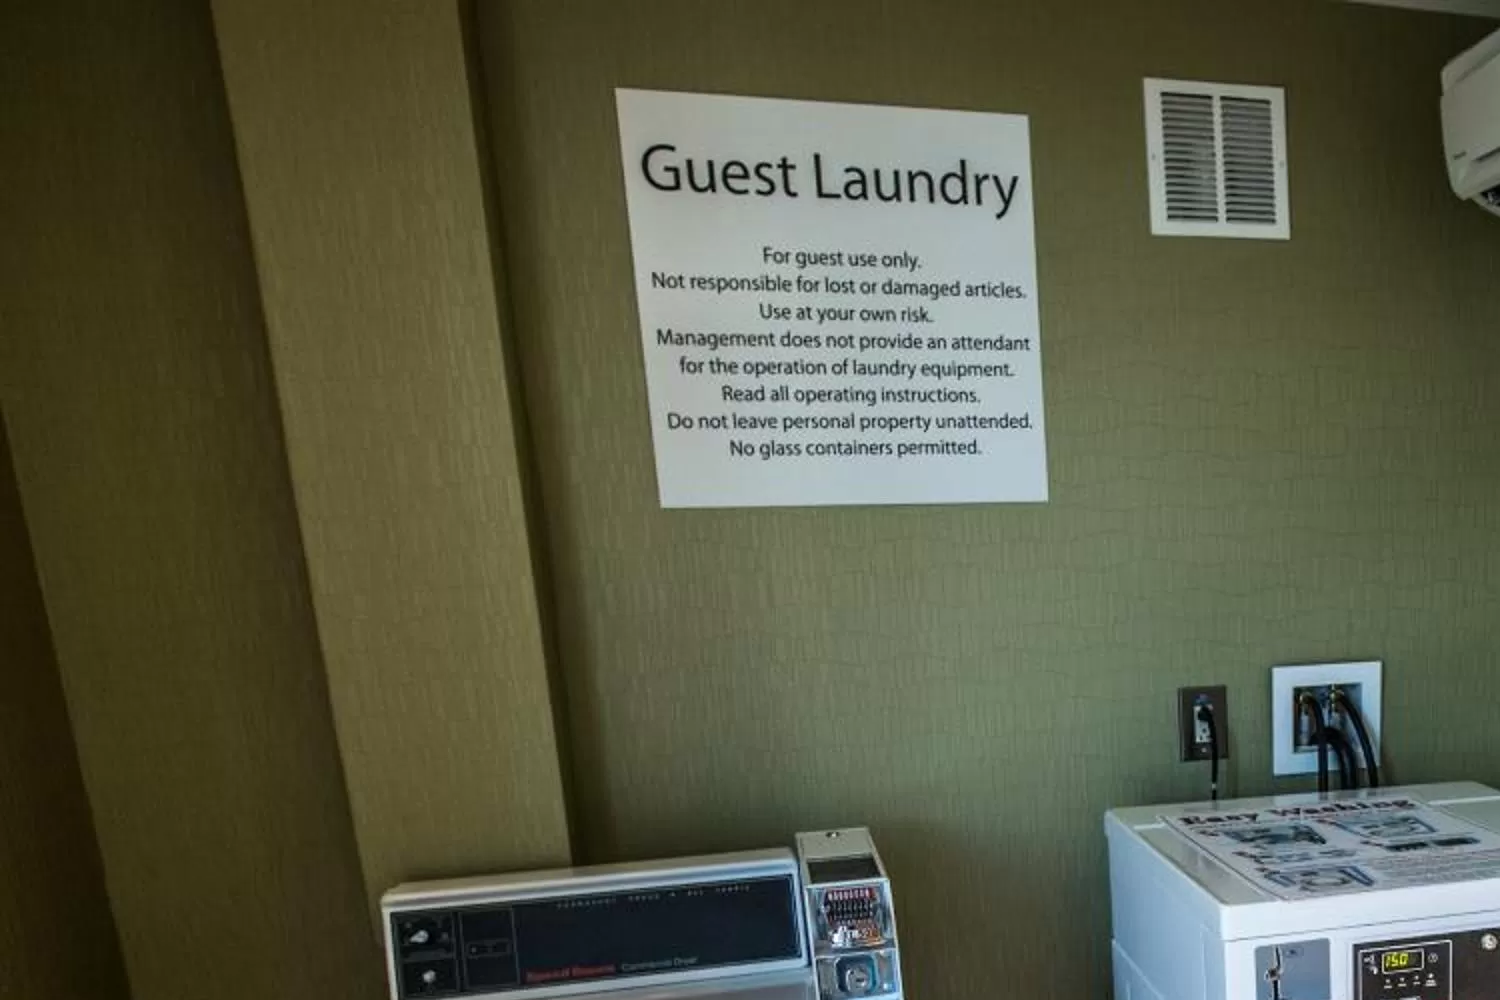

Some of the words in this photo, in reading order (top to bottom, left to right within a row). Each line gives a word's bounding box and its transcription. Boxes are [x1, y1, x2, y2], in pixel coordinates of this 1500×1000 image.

[640, 144, 798, 198] Guest
[812, 154, 1019, 220] Laundry
[763, 246, 792, 265] For
[795, 251, 844, 269] guest
[847, 253, 878, 268] use
[880, 250, 922, 272] only.
[651, 272, 686, 289] Not
[689, 274, 793, 295] responsible
[795, 276, 821, 293] for
[824, 276, 856, 295] lost
[859, 281, 878, 295] or
[881, 279, 961, 300] damaged
[965, 281, 1026, 299] articles.
[759, 303, 792, 321] Use
[796, 306, 814, 321] at
[816, 308, 857, 324] your
[859, 308, 897, 323] own
[901, 305, 934, 323] risk.
[656, 328, 776, 351] Management
[779, 330, 822, 349] does
[825, 334, 856, 349] not
[859, 333, 923, 353] provide
[926, 337, 949, 350] an
[951, 335, 1030, 352] attendant
[679, 356, 705, 375] for
[709, 357, 739, 376] the
[742, 359, 827, 378] operation
[831, 359, 849, 376] of
[851, 359, 917, 379] laundry
[919, 361, 1016, 380] equipment.
[721, 384, 766, 403] Read
[770, 386, 790, 403] all
[793, 386, 877, 406] operating
[881, 387, 981, 404] instructions.
[667, 412, 694, 430] Do
[698, 414, 730, 430] not
[732, 412, 778, 430] leave
[782, 413, 855, 432] personal
[859, 415, 932, 433] property
[935, 413, 1032, 430] unattended.
[730, 440, 755, 457] No
[759, 439, 802, 459] glass
[805, 439, 895, 456] containers
[897, 439, 982, 458] permitted.
